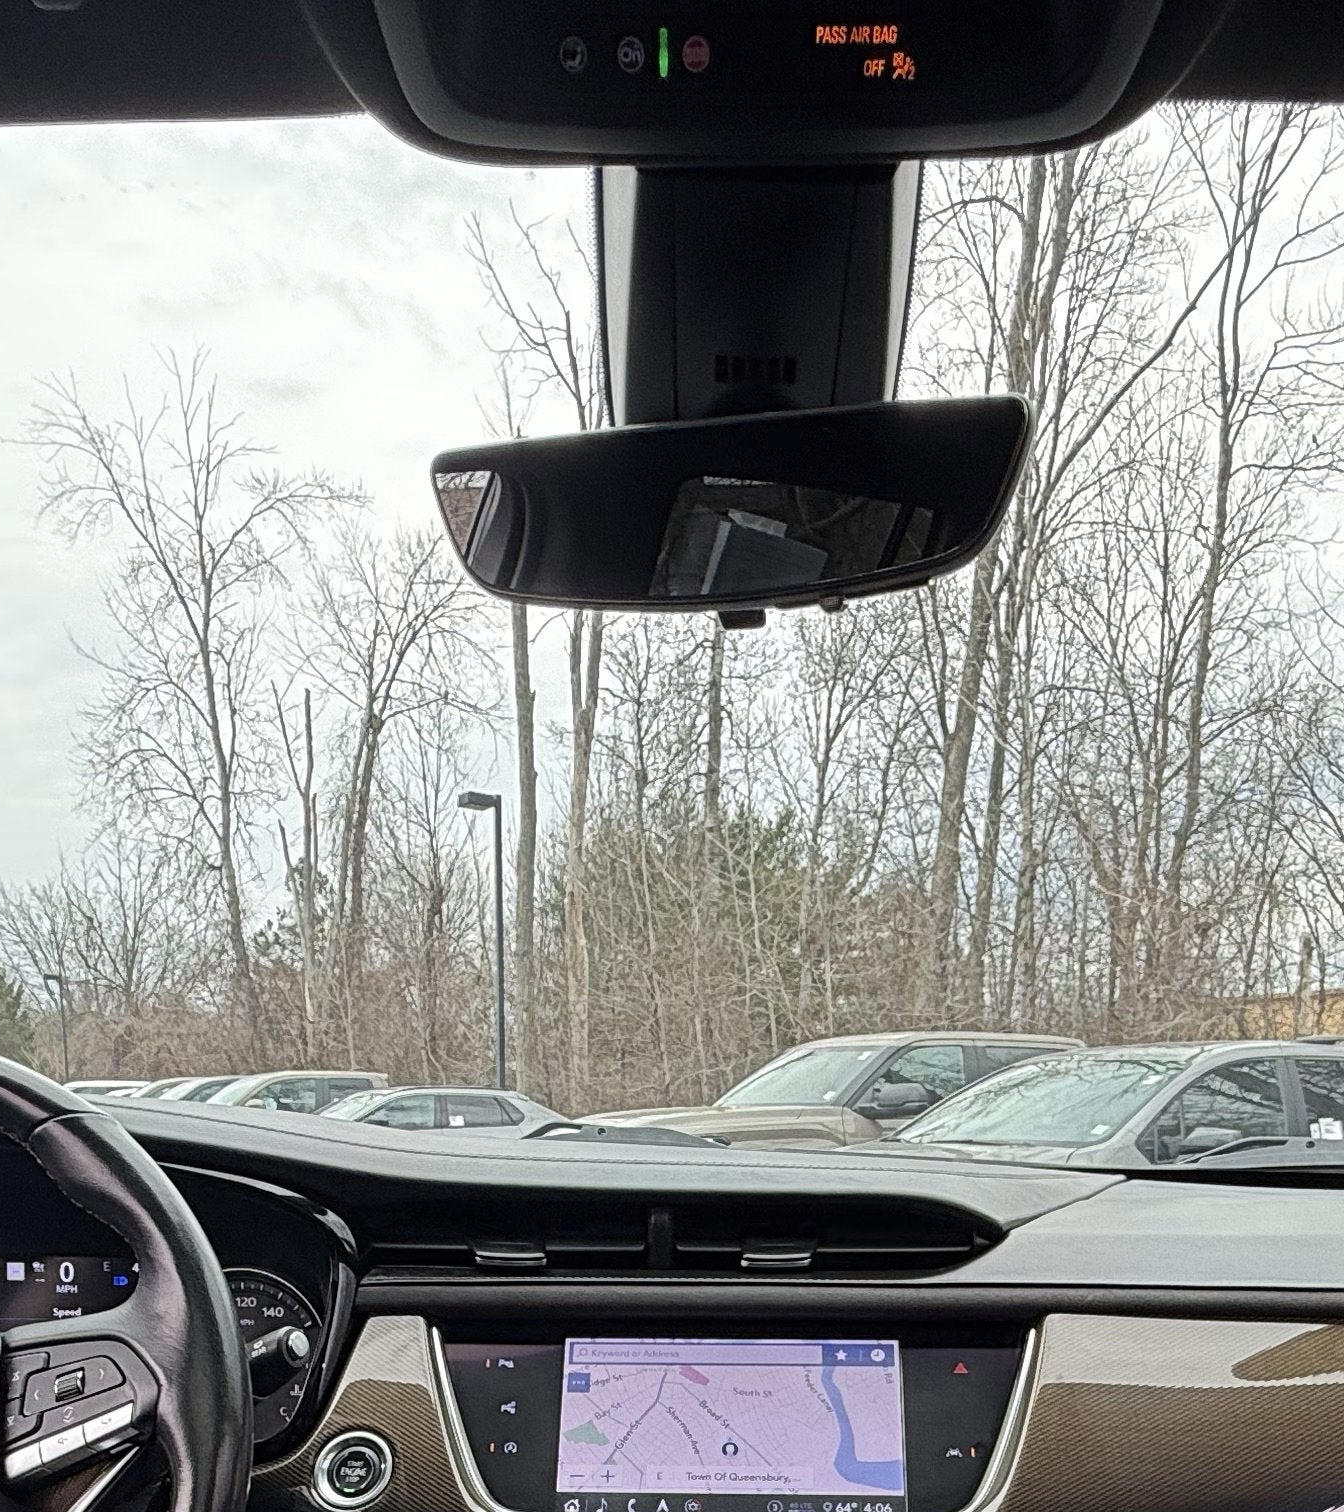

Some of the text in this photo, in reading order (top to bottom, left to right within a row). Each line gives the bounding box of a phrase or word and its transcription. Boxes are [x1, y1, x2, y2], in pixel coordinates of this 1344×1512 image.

[816, 25, 898, 44] PASS AIR BAG
[864, 60, 885, 77] OFF
[59, 1261, 75, 1283] 0
[103, 1261, 111, 1272] E
[56, 1285, 78, 1294] MPH
[236, 1296, 256, 1307] 120
[53, 1307, 82, 1318] Speed
[262, 1306, 284, 1317] 140
[591, 1349, 629, 1359] Keyword
[643, 1350, 679, 1358] Address
[732, 1387, 760, 1397] South
[594, 1408, 611, 1421] Bay
[698, 1400, 722, 1421] Broad
[665, 1406, 693, 1440] Sherman
[615, 1430, 633, 1450] Glen
[686, 1472, 711, 1480] Town
[714, 1472, 727, 1480] Of
